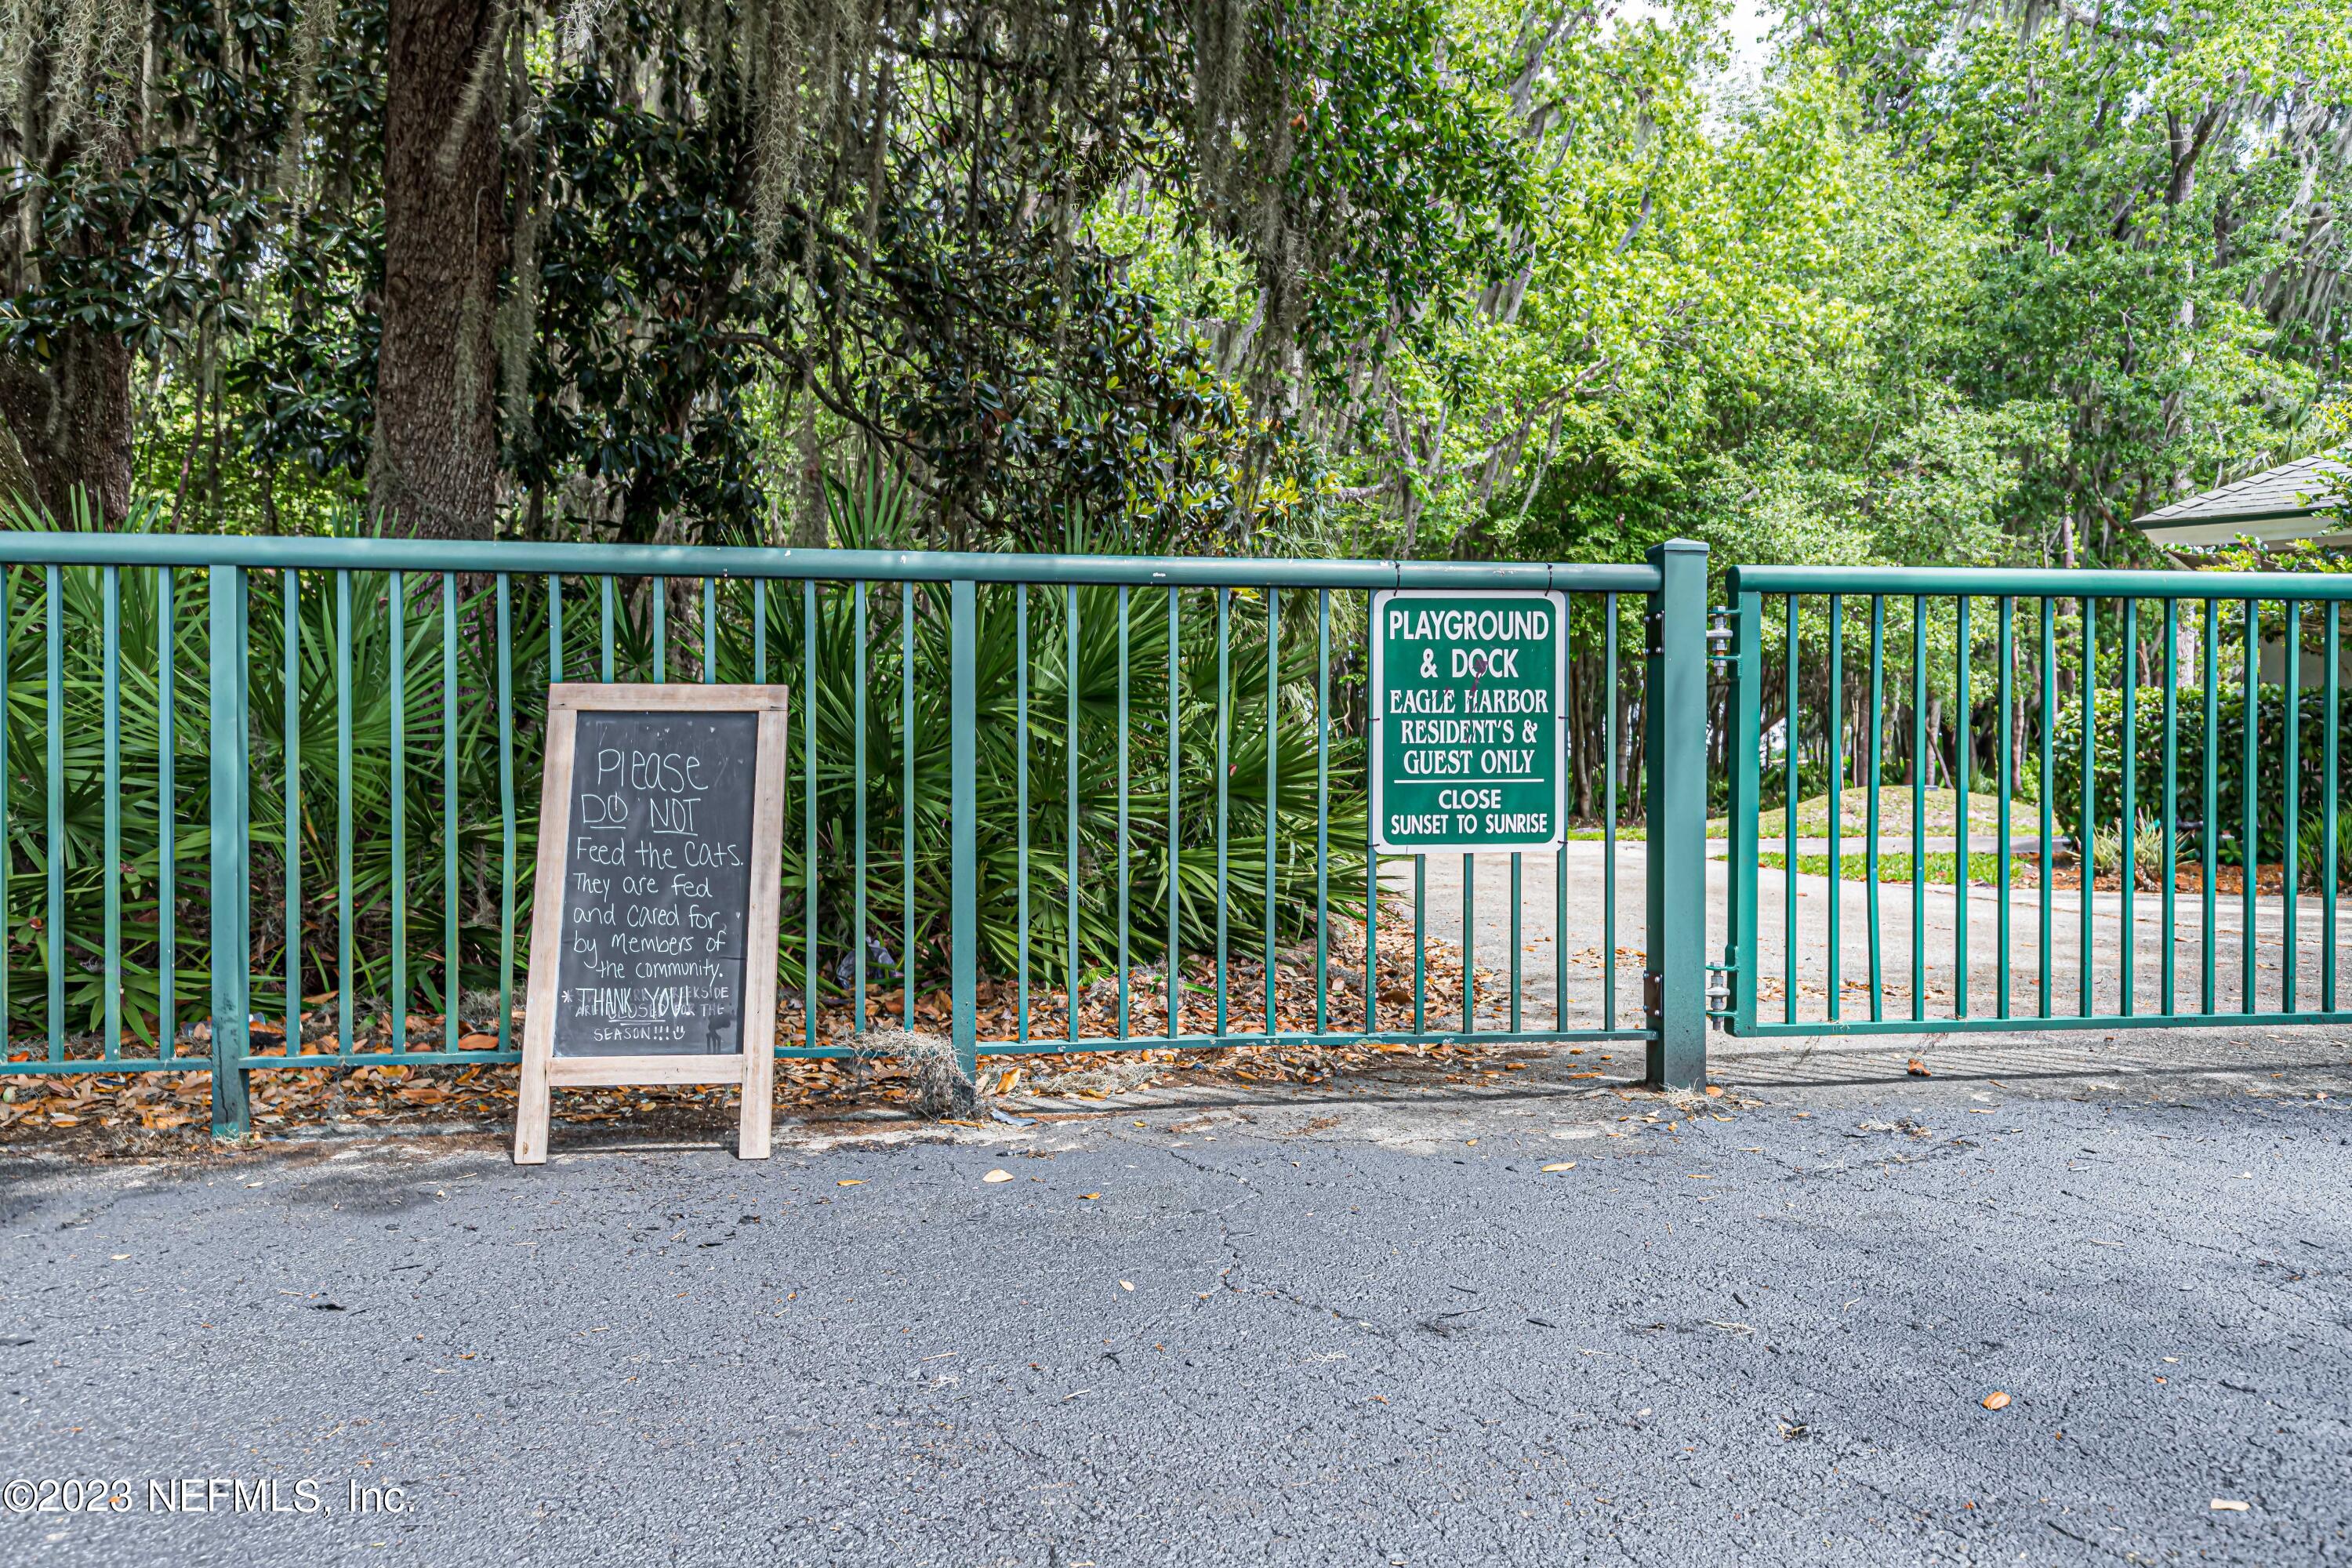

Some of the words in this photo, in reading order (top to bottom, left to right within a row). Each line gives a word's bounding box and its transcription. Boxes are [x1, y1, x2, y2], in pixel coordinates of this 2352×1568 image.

[1389, 610, 1549, 641] PLAYGROUND
[1420, 648, 1439, 678] &
[1452, 648, 1519, 678] DOCK
[1389, 689, 1456, 714] EAGLE
[1464, 688, 1549, 714] HARBOR
[1400, 719, 1515, 744] RESIDENT'S
[1522, 719, 1538, 743] &
[1403, 750, 1473, 775] GUEST
[1480, 750, 1535, 774] ONLY
[581, 792, 628, 823] DO
[650, 798, 701, 832] NOT
[1438, 789, 1501, 810] CLOSE
[1391, 814, 1449, 835] SUNSET
[1457, 814, 1478, 834] TO
[1485, 813, 1548, 834] SUNRISE
[576, 837, 626, 866] Feed
[635, 840, 677, 869] the
[572, 873, 610, 902] They
[622, 876, 659, 895] are
[573, 903, 615, 926] and
[688, 904, 720, 929] for
[573, 930, 597, 969] by
[706, 930, 726, 952] of
[596, 960, 626, 978] the
[575, 987, 632, 1017] THANK
[644, 985, 691, 1018] YOU!
[700, 1004, 724, 1017] THE
